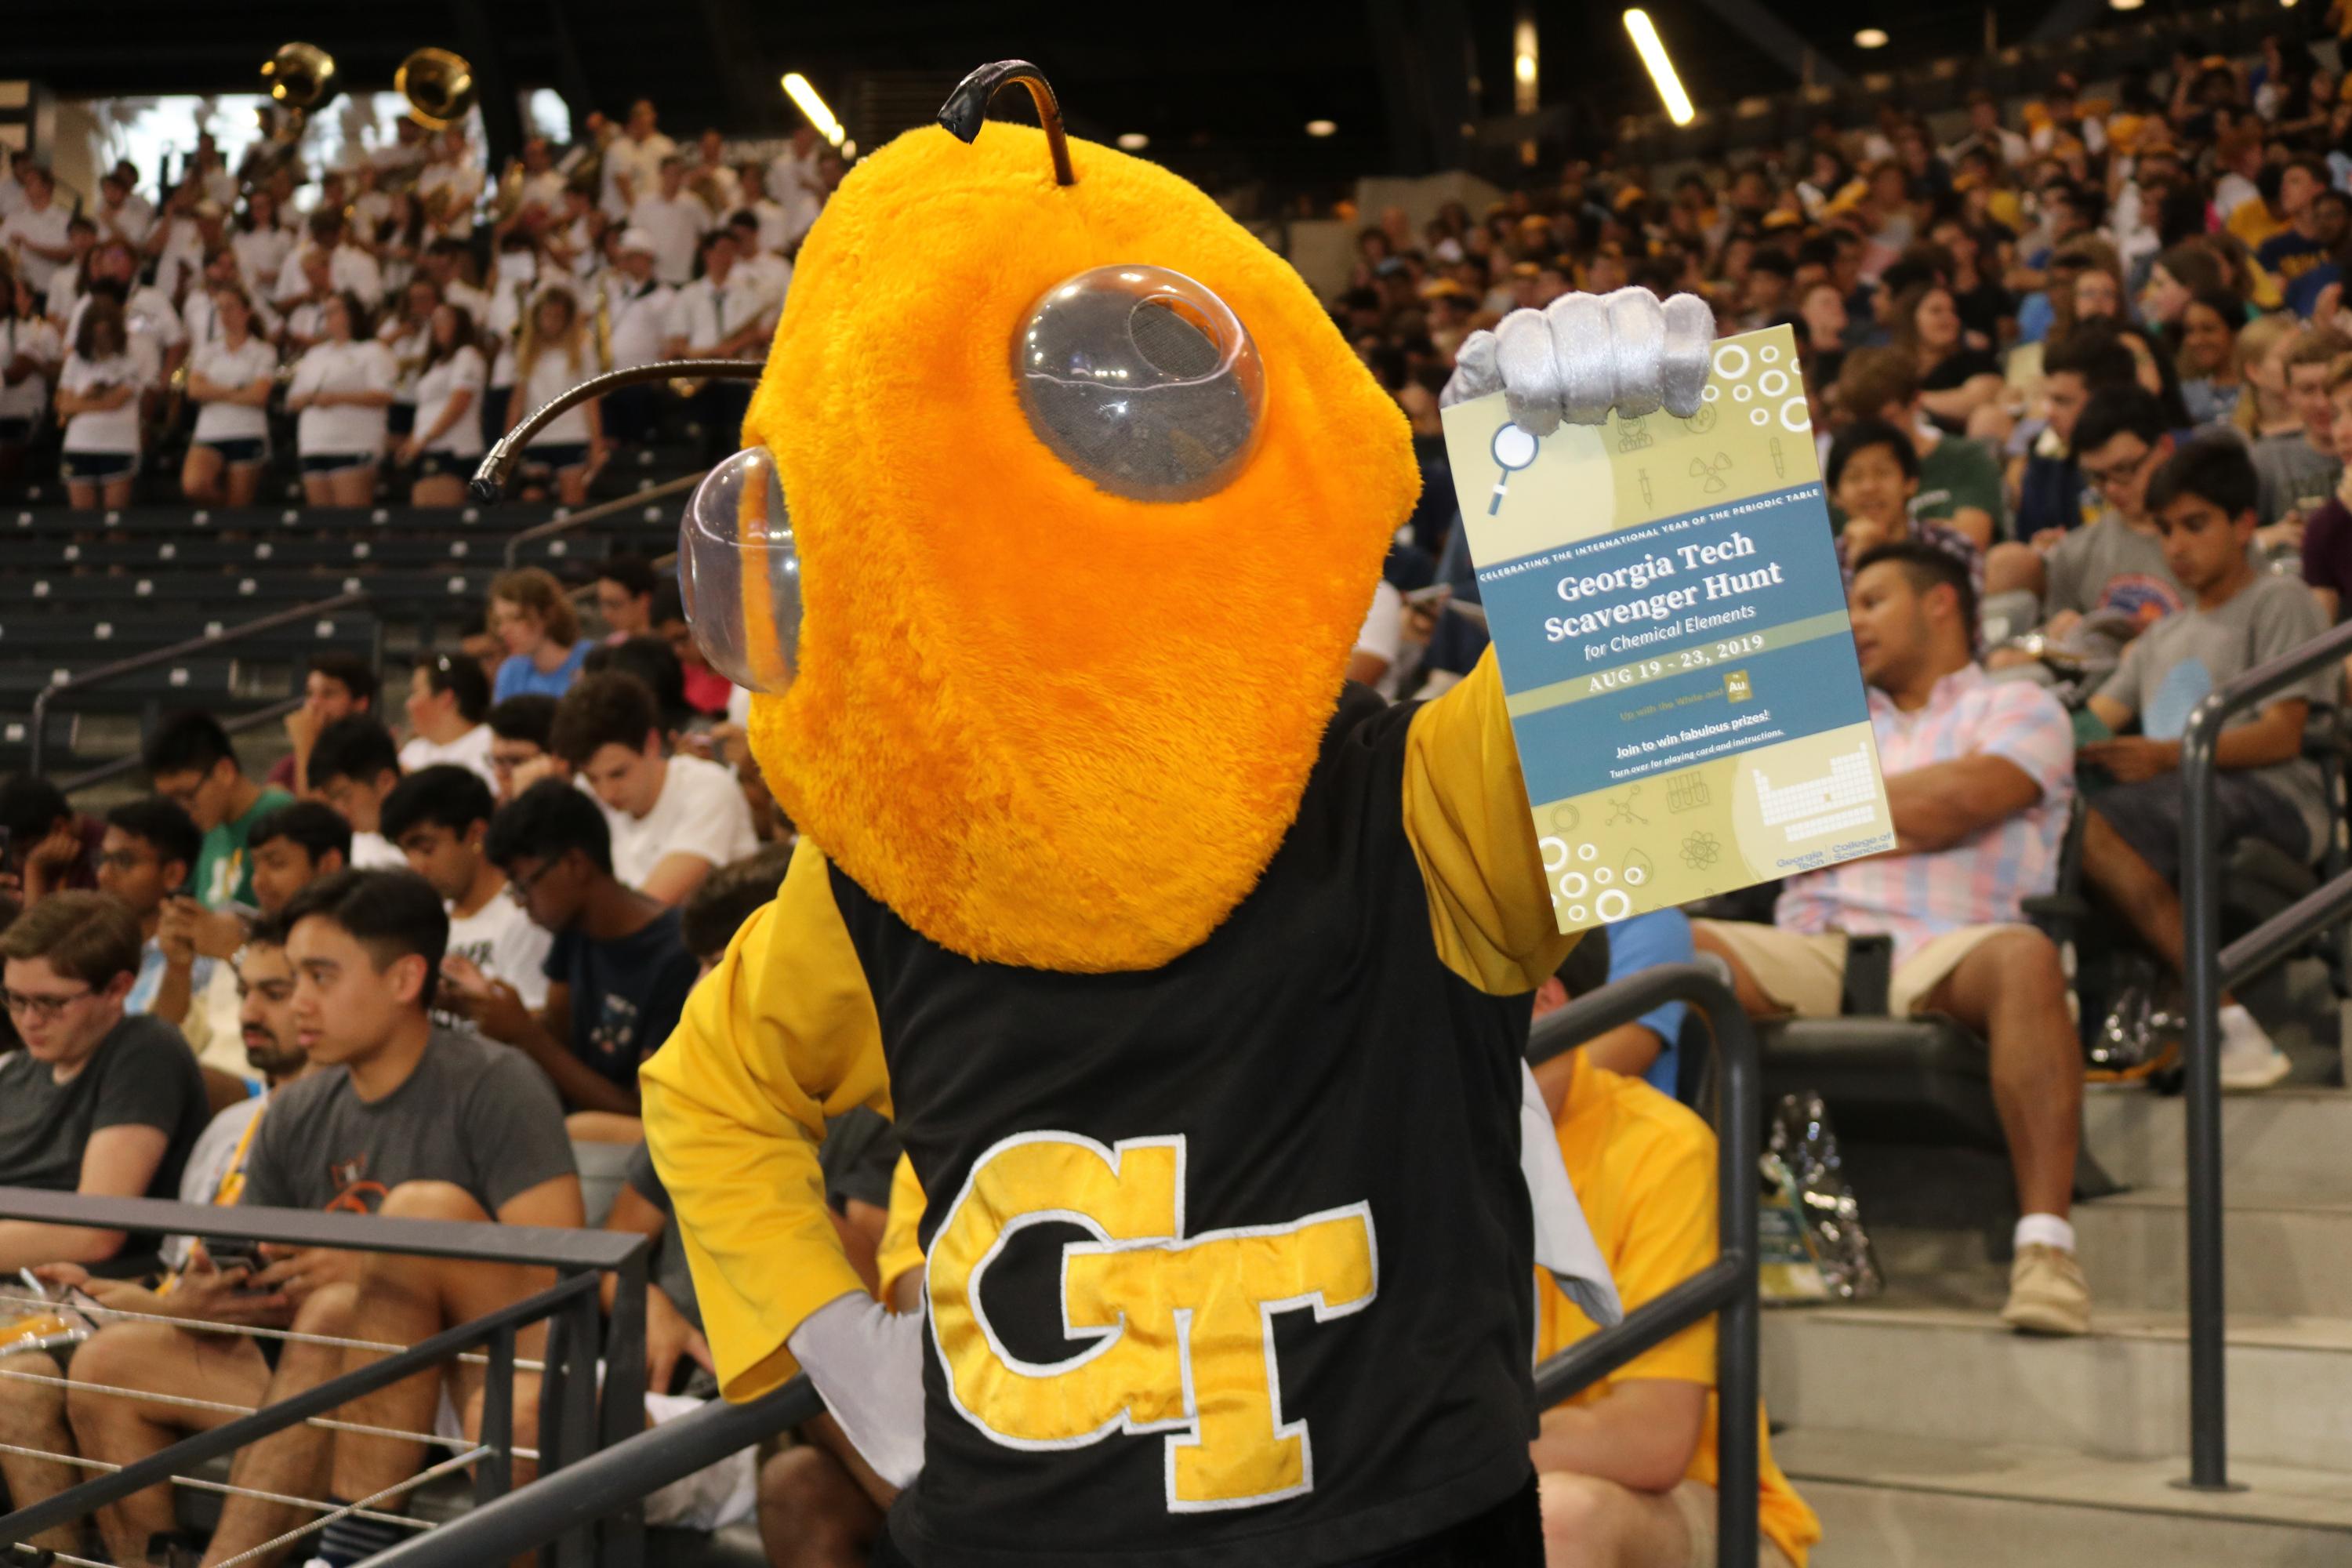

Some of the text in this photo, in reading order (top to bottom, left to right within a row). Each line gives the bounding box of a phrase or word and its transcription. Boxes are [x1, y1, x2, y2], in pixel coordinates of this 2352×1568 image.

[1479, 488, 1820, 581] CELEBRATING THE INTERNATIONAL YEAR OF THE PERIODIC TABLE
[1556, 532, 1757, 601] Georgia Tech
[1544, 561, 1784, 642] Scavenger Hunt
[1584, 604, 1756, 661] for Chemical Elements
[1588, 668, 1632, 691] AUG
[1638, 661, 1661, 678] 19
[1680, 649, 1712, 667] 23,
[1717, 634, 1763, 658] 2019
[1619, 710, 1635, 721] Up
[1636, 704, 1656, 717] with
[1658, 699, 1673, 710] the
[1675, 694, 1703, 705] White
[1705, 688, 1722, 699] and
[1729, 681, 1746, 692] Au
[1610, 728, 1784, 778] Turn over for playing card and instructions.
[1616, 709, 1770, 758] Join to win fabulous prizes!
[1776, 850, 1823, 867] Georgia
[1798, 859, 1824, 869] Tech
[1832, 832, 1892, 852] College of
[1833, 843, 1889, 861] Sciences
[925, 1129, 1378, 1513] GT
